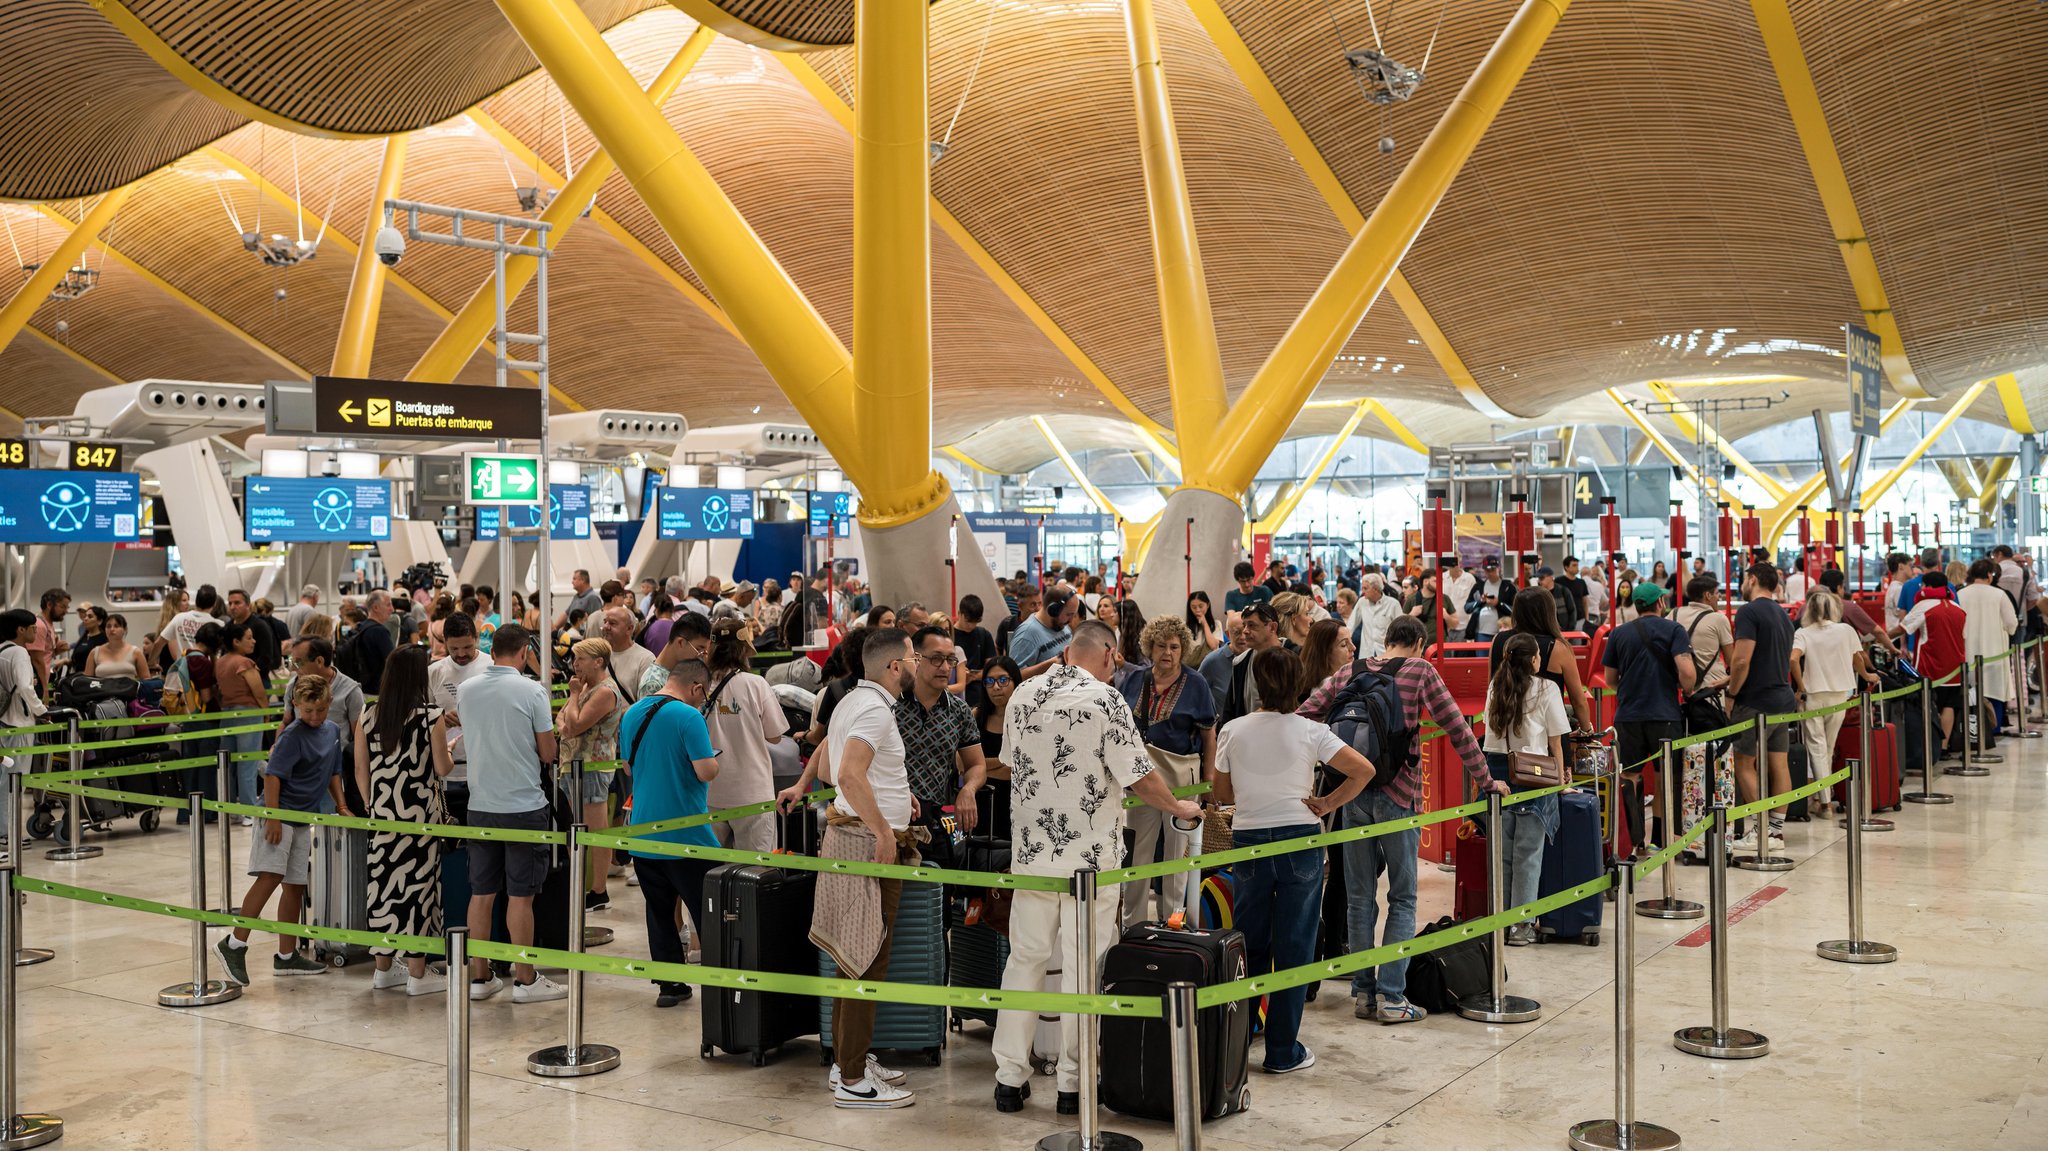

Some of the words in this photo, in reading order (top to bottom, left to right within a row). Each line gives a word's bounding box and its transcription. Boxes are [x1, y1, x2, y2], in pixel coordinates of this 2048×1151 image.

[395, 401, 431, 415] Boarding
[432, 403, 455, 416] gates
[395, 415, 433, 428] Puertas
[434, 416, 447, 428] de
[448, 417, 493, 431] embarque
[76, 446, 117, 467] 847
[252, 508, 285, 516] Invisible
[252, 517, 295, 527] Disabilities
[251, 528, 271, 537] Badge
[1420, 741, 1432, 848] Ceck-in
